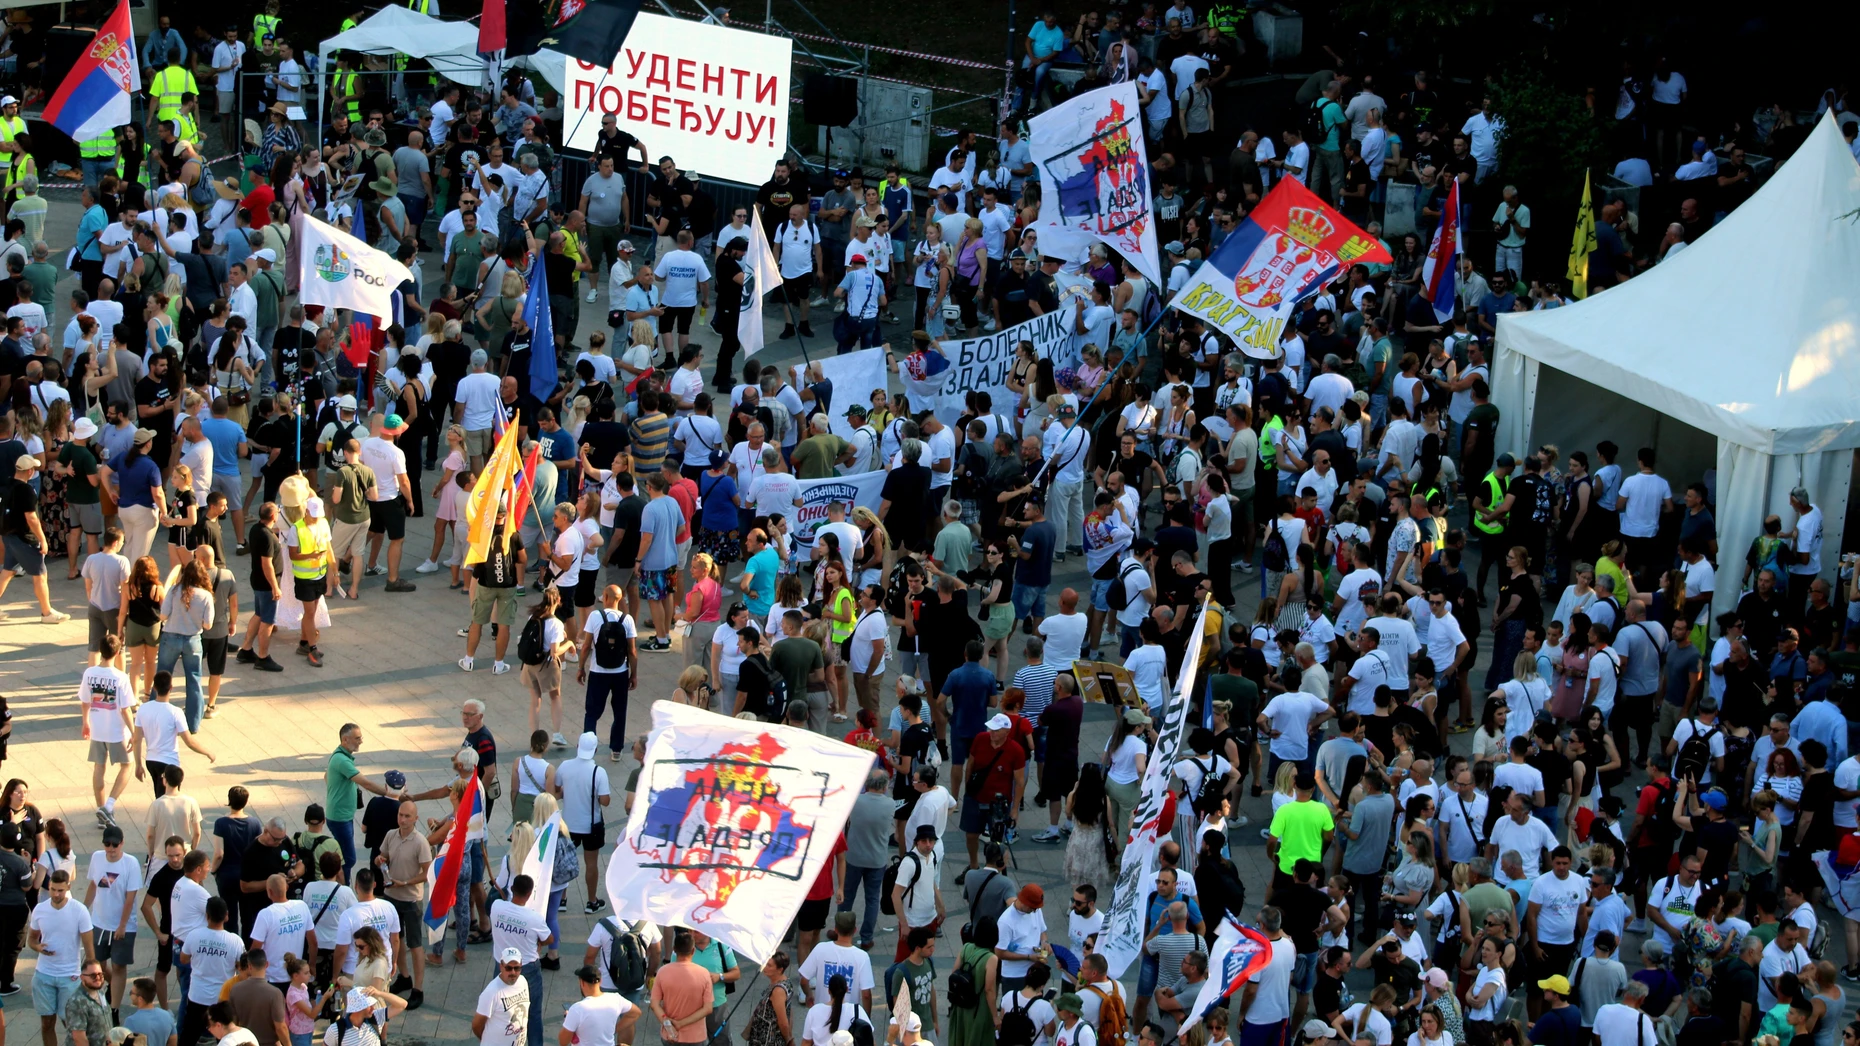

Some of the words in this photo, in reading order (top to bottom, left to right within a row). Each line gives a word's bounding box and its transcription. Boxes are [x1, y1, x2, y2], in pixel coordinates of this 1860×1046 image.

[575, 48, 778, 106] УДЕНТИ
[574, 79, 776, 148] ПОБЕЂУЈУ!
[958, 309, 1068, 367] БОЛЕСНИК
[494, 552, 502, 583] adidas
[494, 921, 528, 938] ЈАДАР!
[197, 946, 228, 958] ЈАДАР!
[824, 964, 854, 978] RUN
